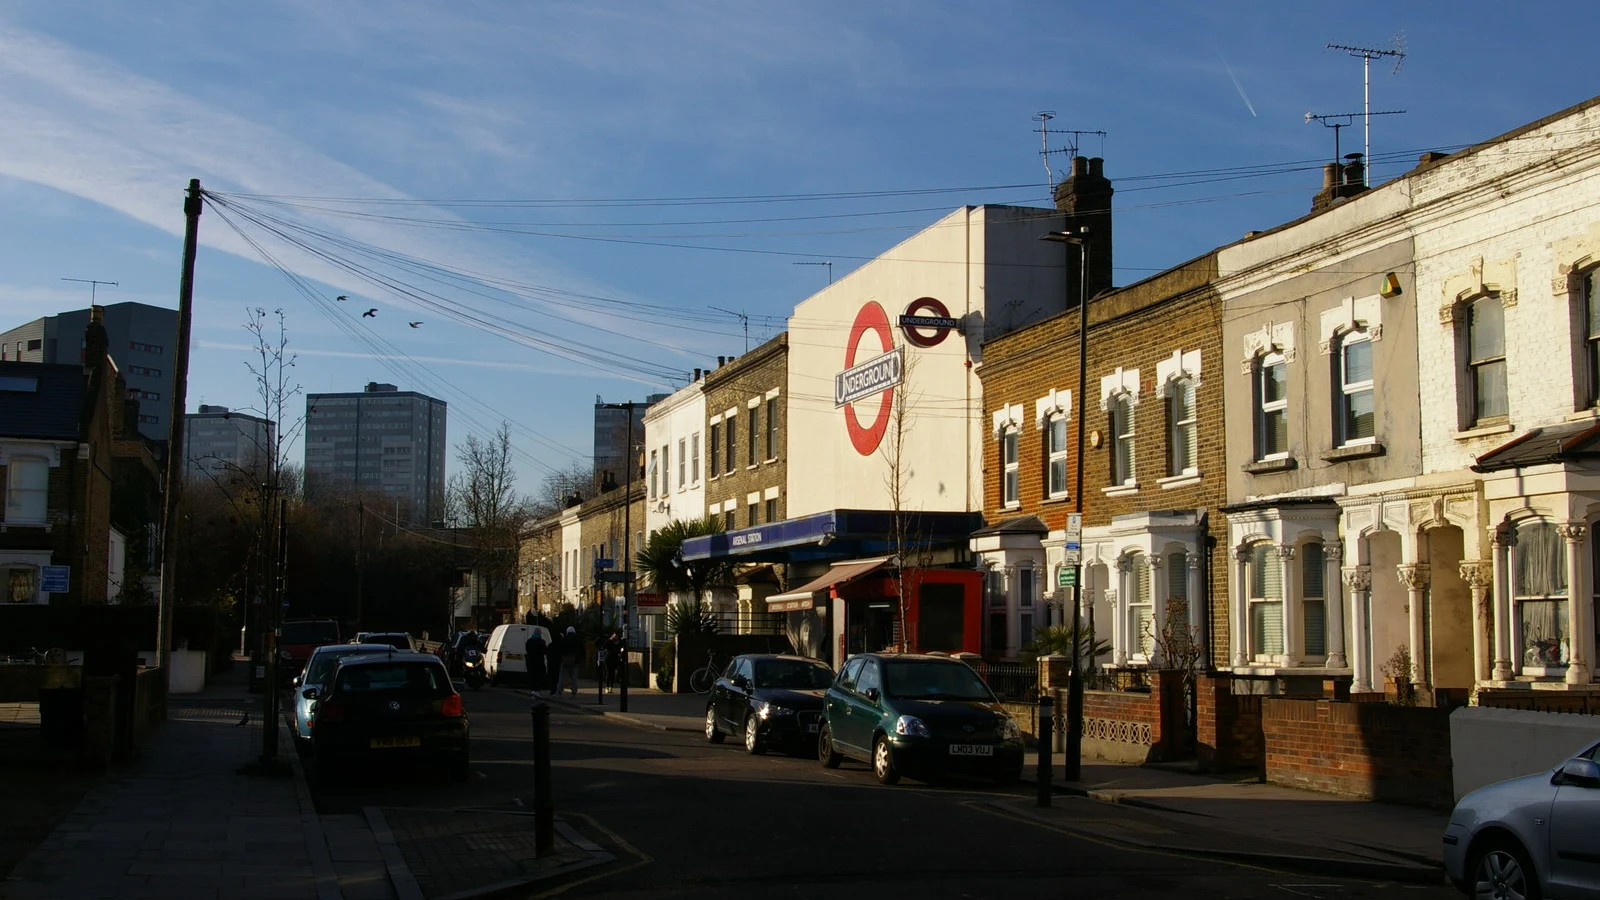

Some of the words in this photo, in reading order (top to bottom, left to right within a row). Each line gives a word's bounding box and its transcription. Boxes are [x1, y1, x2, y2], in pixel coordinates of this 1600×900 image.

[901, 317, 955, 327] UNDERGROUND
[836, 351, 901, 403] UNDERGROUND
[732, 535, 747, 546] ARSENAL
[748, 532, 762, 544] STATION
